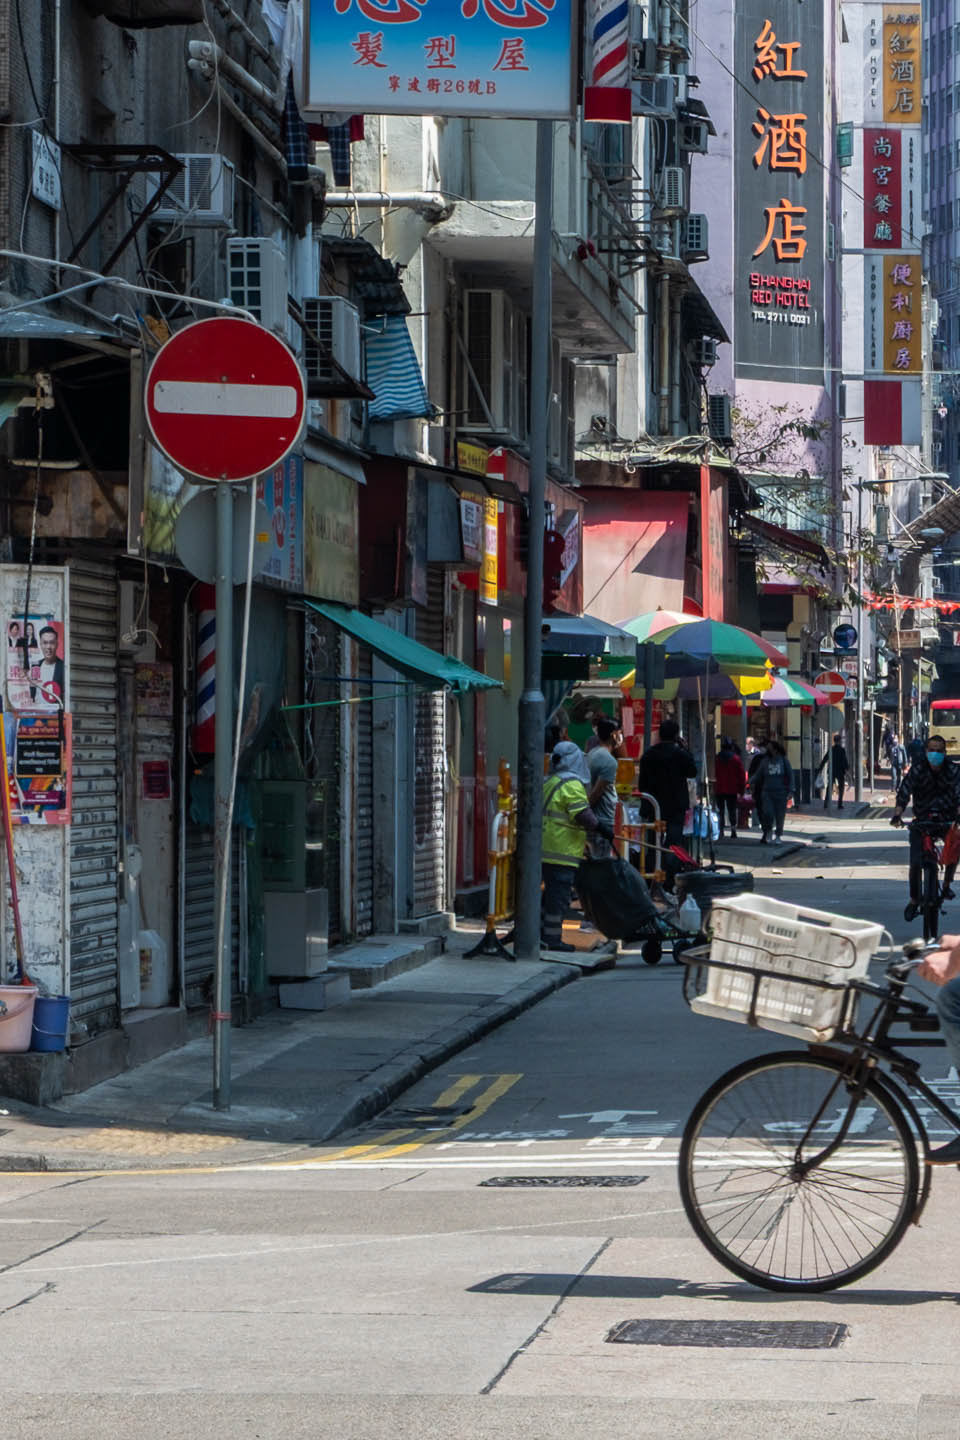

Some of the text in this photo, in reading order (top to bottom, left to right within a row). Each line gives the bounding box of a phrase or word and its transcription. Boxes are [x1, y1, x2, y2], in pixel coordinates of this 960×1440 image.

[352, 31, 530, 72] 髮型屋
[889, 31, 915, 113] 紅酒店
[753, 19, 809, 260] 紅酒店
[872, 136, 893, 242] 尚宮餐廳
[750, 272, 811, 291] SHANGHAI
[752, 290, 811, 308] RED HOTEL
[767, 311, 788, 323] 2711
[890, 263, 914, 369] 便利廚房
